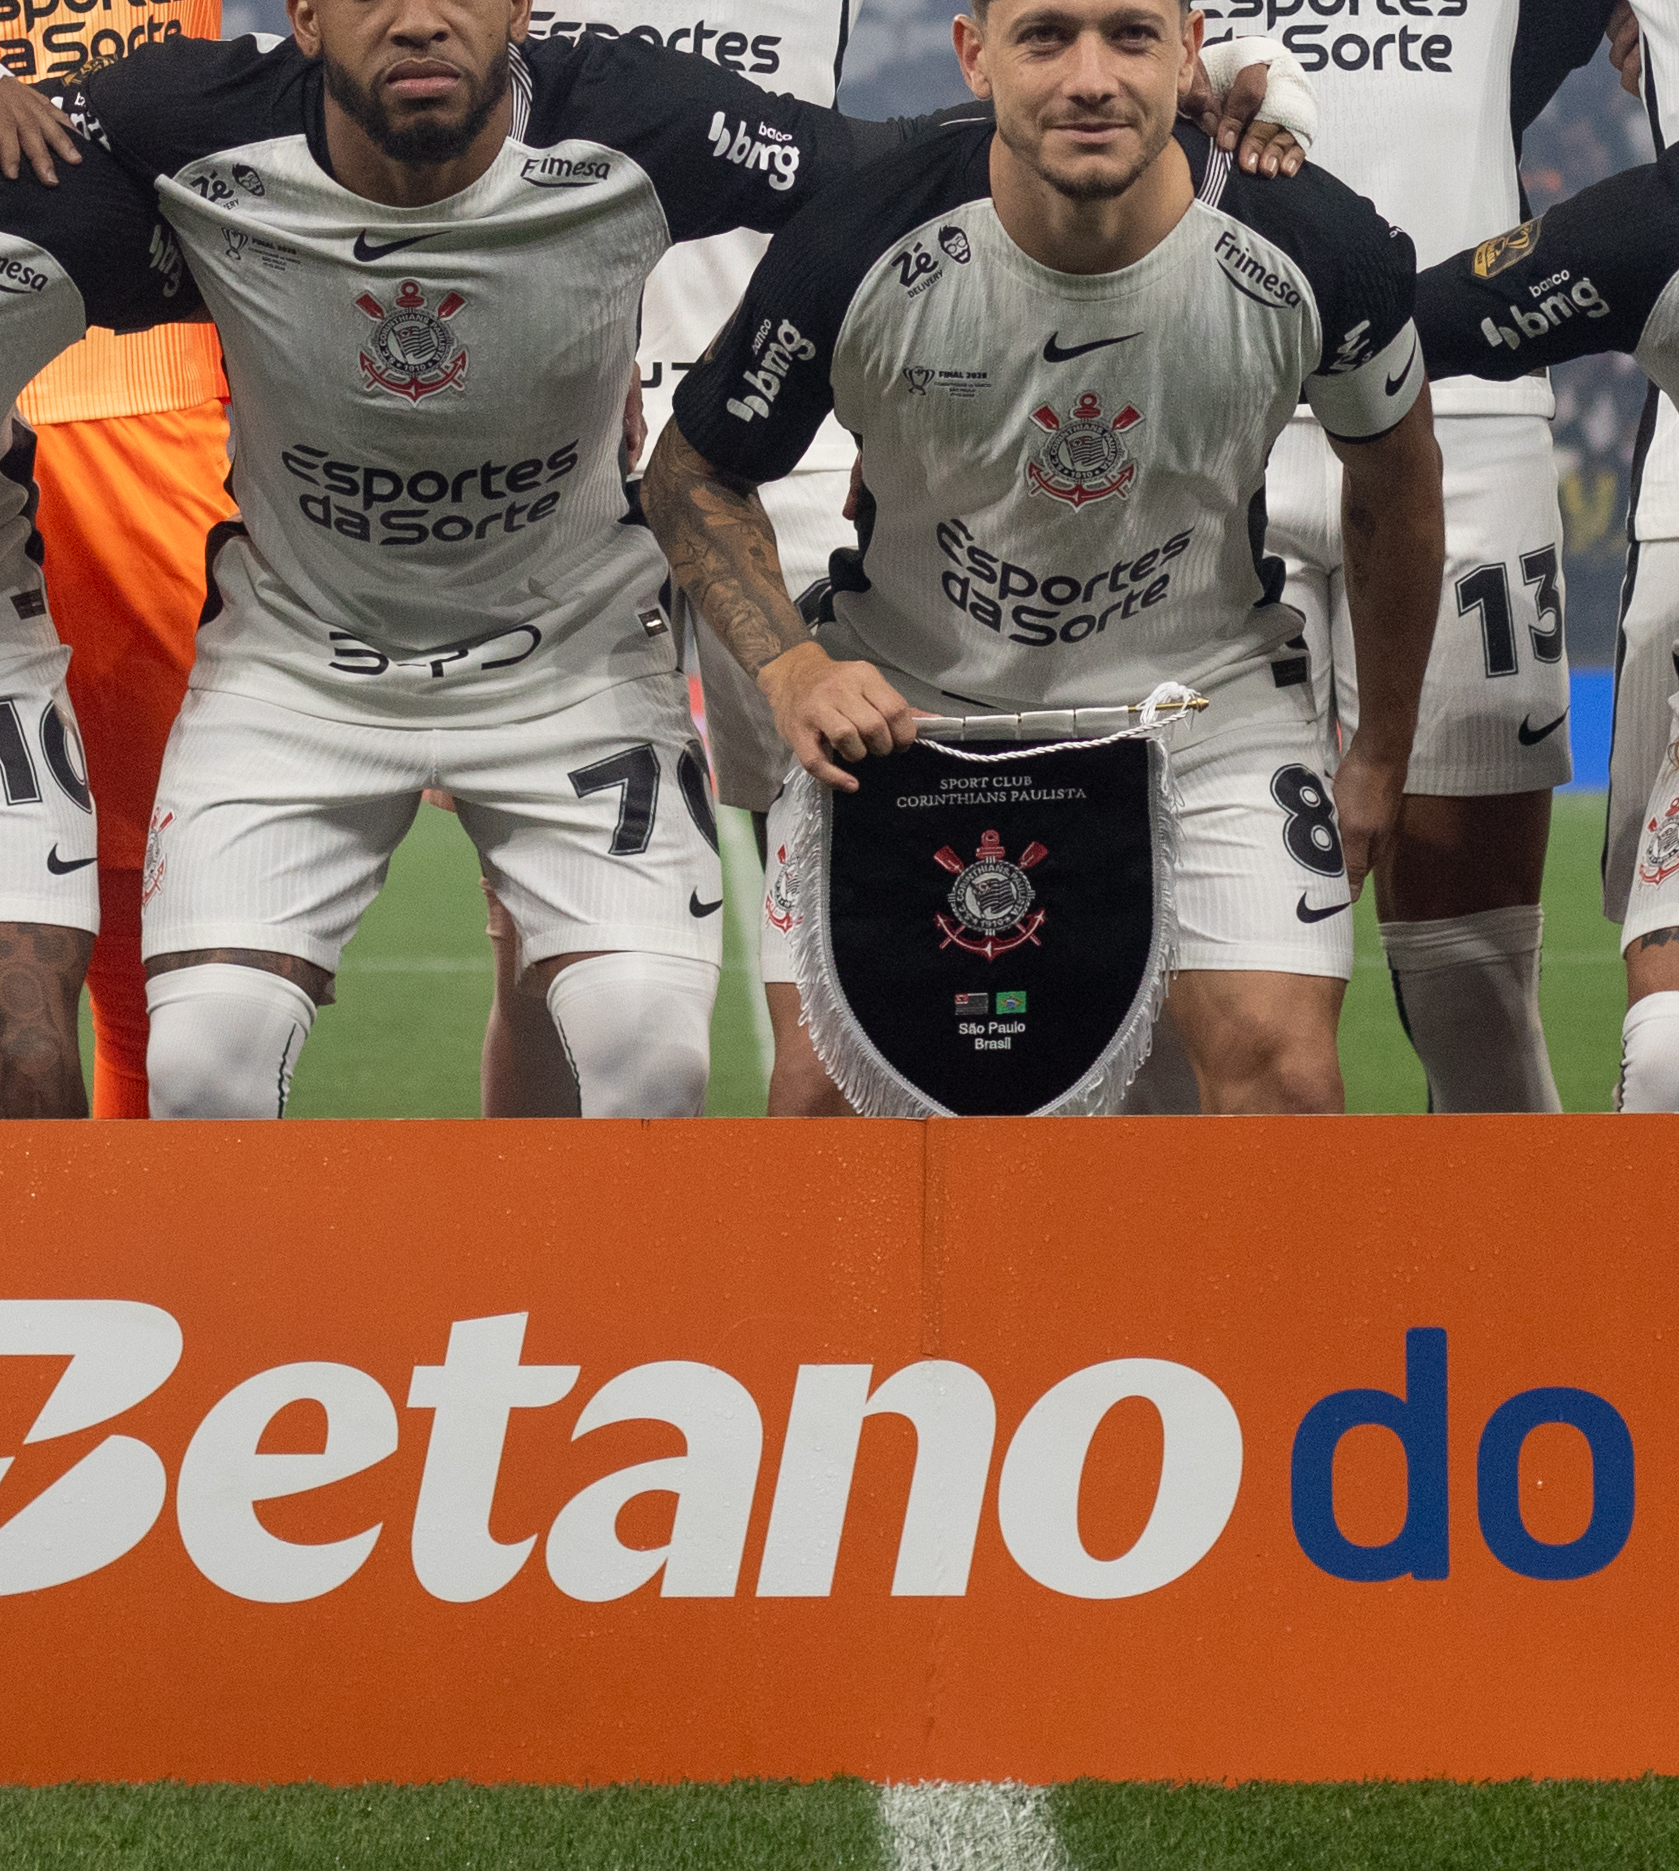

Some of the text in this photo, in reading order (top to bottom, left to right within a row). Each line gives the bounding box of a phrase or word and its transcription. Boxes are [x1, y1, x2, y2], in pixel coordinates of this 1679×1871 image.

[1281, 25, 1453, 74] Sorte
[890, 241, 939, 288] Zé
[907, 269, 944, 299] DELIVERY
[1214, 231, 1302, 309] Frimesa
[1509, 277, 1612, 340] bmg
[742, 319, 817, 403] bmg
[752, 318, 772, 356] banco
[404, 363, 427, 372] 1910
[282, 439, 578, 510] Esportes
[1071, 470, 1094, 480] 1910
[299, 490, 561, 547] da Sorte
[936, 519, 1194, 603] Esportes
[940, 571, 1171, 648] da Sorte
[1453, 542, 1563, 679] 13
[896, 787, 1087, 809] CORINTHIANS PAULISTA
[940, 776, 1033, 791] SPORT CLUB
[1269, 762, 1346, 879] 8
[981, 919, 1004, 928] 1910
[958, 1021, 1026, 1035] São Paulo
[974, 1036, 1012, 1050] Brasil
[1288, 1325, 1637, 1582] do
